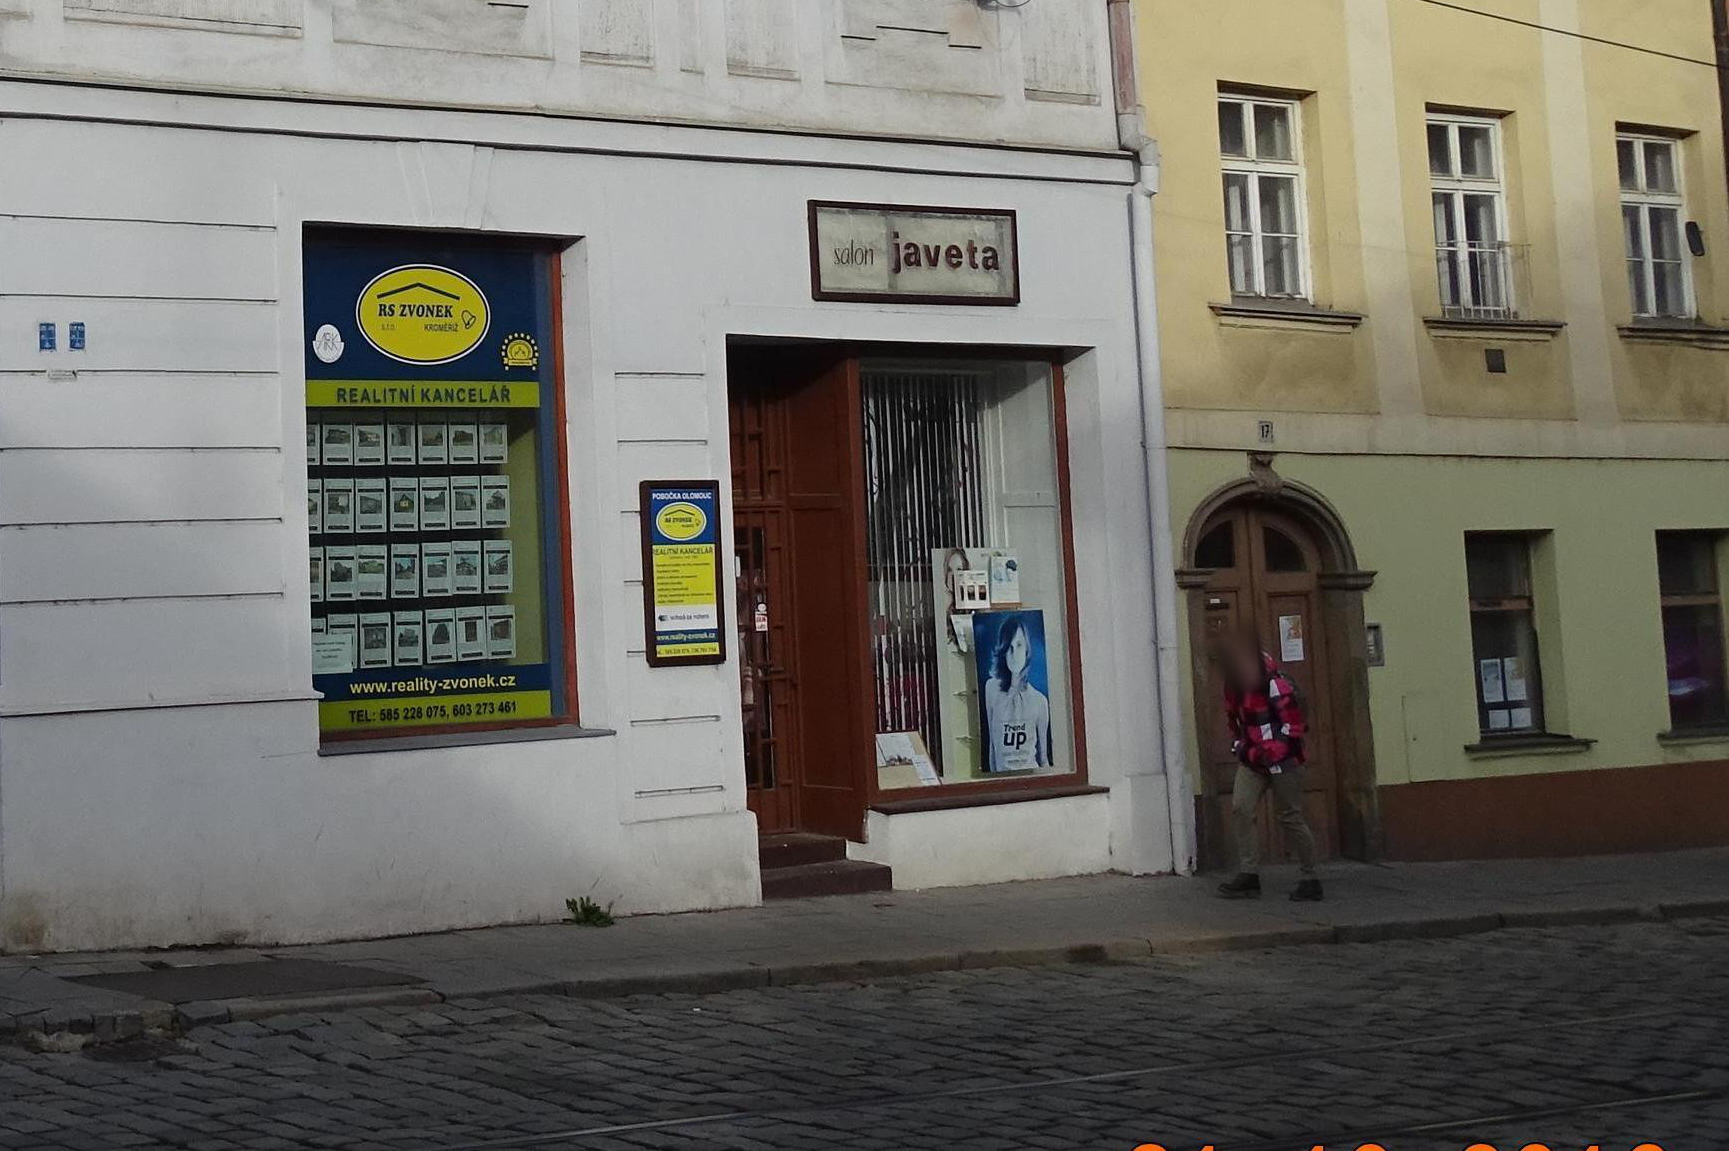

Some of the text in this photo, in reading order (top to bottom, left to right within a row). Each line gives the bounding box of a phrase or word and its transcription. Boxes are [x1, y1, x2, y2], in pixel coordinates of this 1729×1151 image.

[834, 231, 1000, 274] salon javeta
[378, 304, 453, 318] RS ZVONEK
[337, 385, 511, 403] REALITNÍ KANCELÁŘ
[350, 674, 516, 694] www.reality-zvonek.cz
[349, 709, 376, 723] TEL:
[403, 707, 423, 720] 228
[426, 705, 450, 719] 075,
[475, 702, 495, 715] 273
[1004, 731, 1027, 750] up
